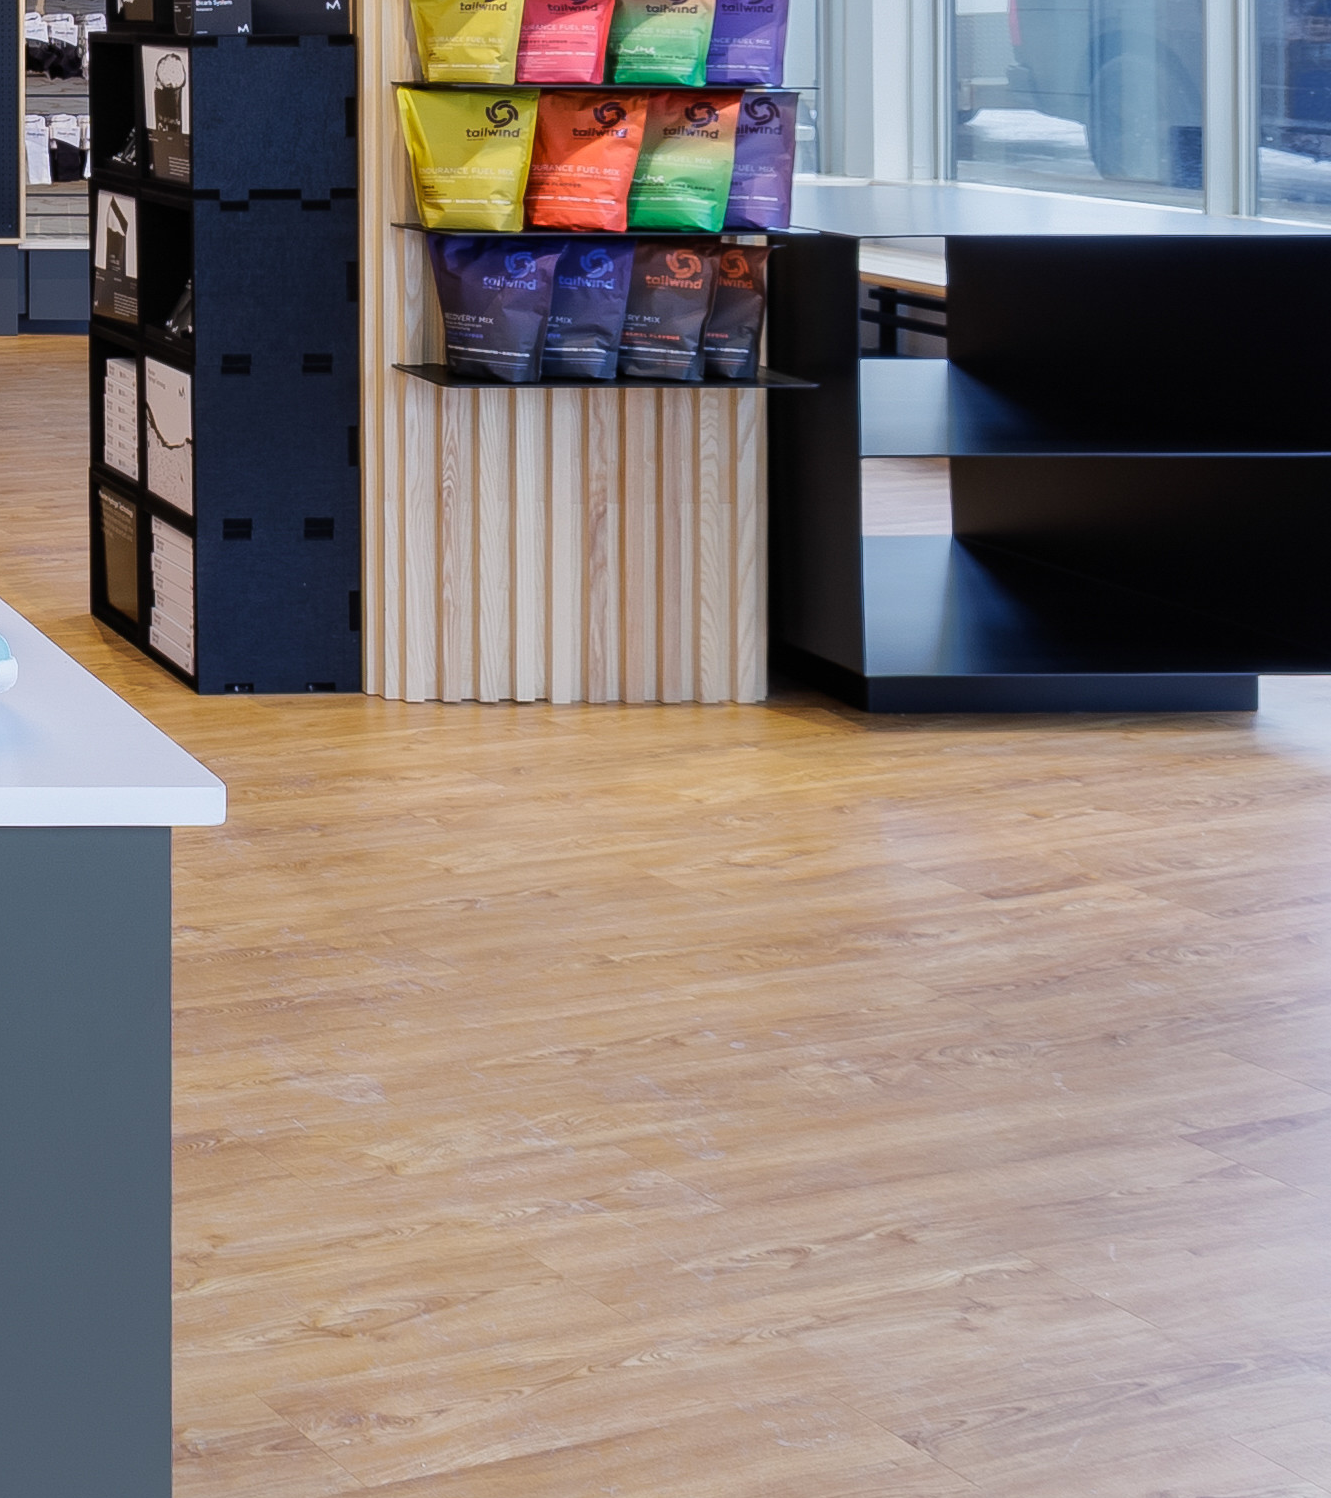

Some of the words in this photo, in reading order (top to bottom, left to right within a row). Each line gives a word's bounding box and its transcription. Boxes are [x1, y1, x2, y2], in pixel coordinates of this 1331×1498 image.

[460, 2, 507, 12] tailwind
[547, 3, 599, 12] tailwind
[646, 4, 698, 14] tailwind
[722, 3, 774, 13] tailwind
[466, 128, 521, 138] tailwind
[663, 127, 719, 139] tailwind
[645, 276, 703, 290] tailwind
[479, 316, 494, 324] MIX
[556, 316, 573, 324] MIX
